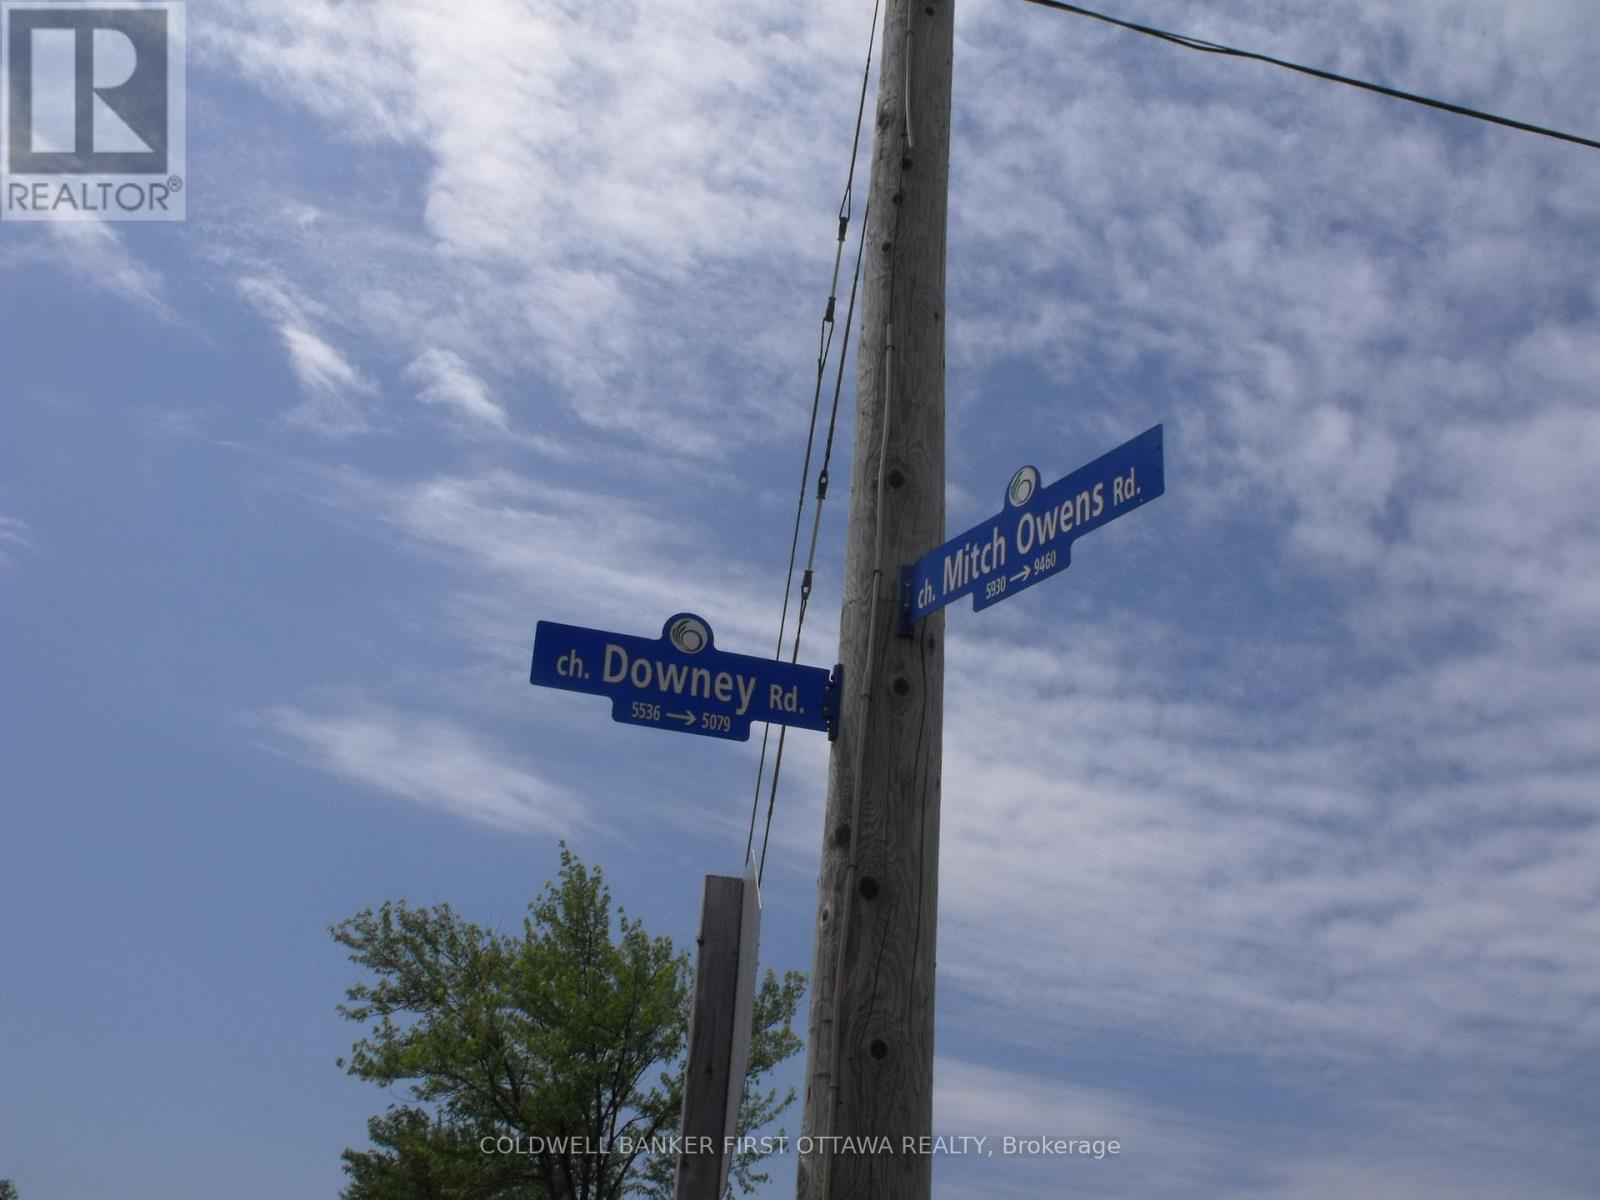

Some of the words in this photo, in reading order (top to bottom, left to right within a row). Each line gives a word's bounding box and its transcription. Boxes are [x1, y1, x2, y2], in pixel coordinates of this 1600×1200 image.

[917, 578, 936, 609] ch.
[942, 526, 1006, 596] Mitch
[1016, 481, 1104, 555] Owens
[1113, 466, 1141, 507] Rd.
[985, 575, 1006, 600] 5930
[1034, 550, 1057, 576] 9460
[556, 648, 589, 680] ch.
[602, 643, 756, 715] Downey
[768, 683, 805, 714] Rd.
[631, 701, 661, 721] 5536
[701, 712, 731, 732] 5079
